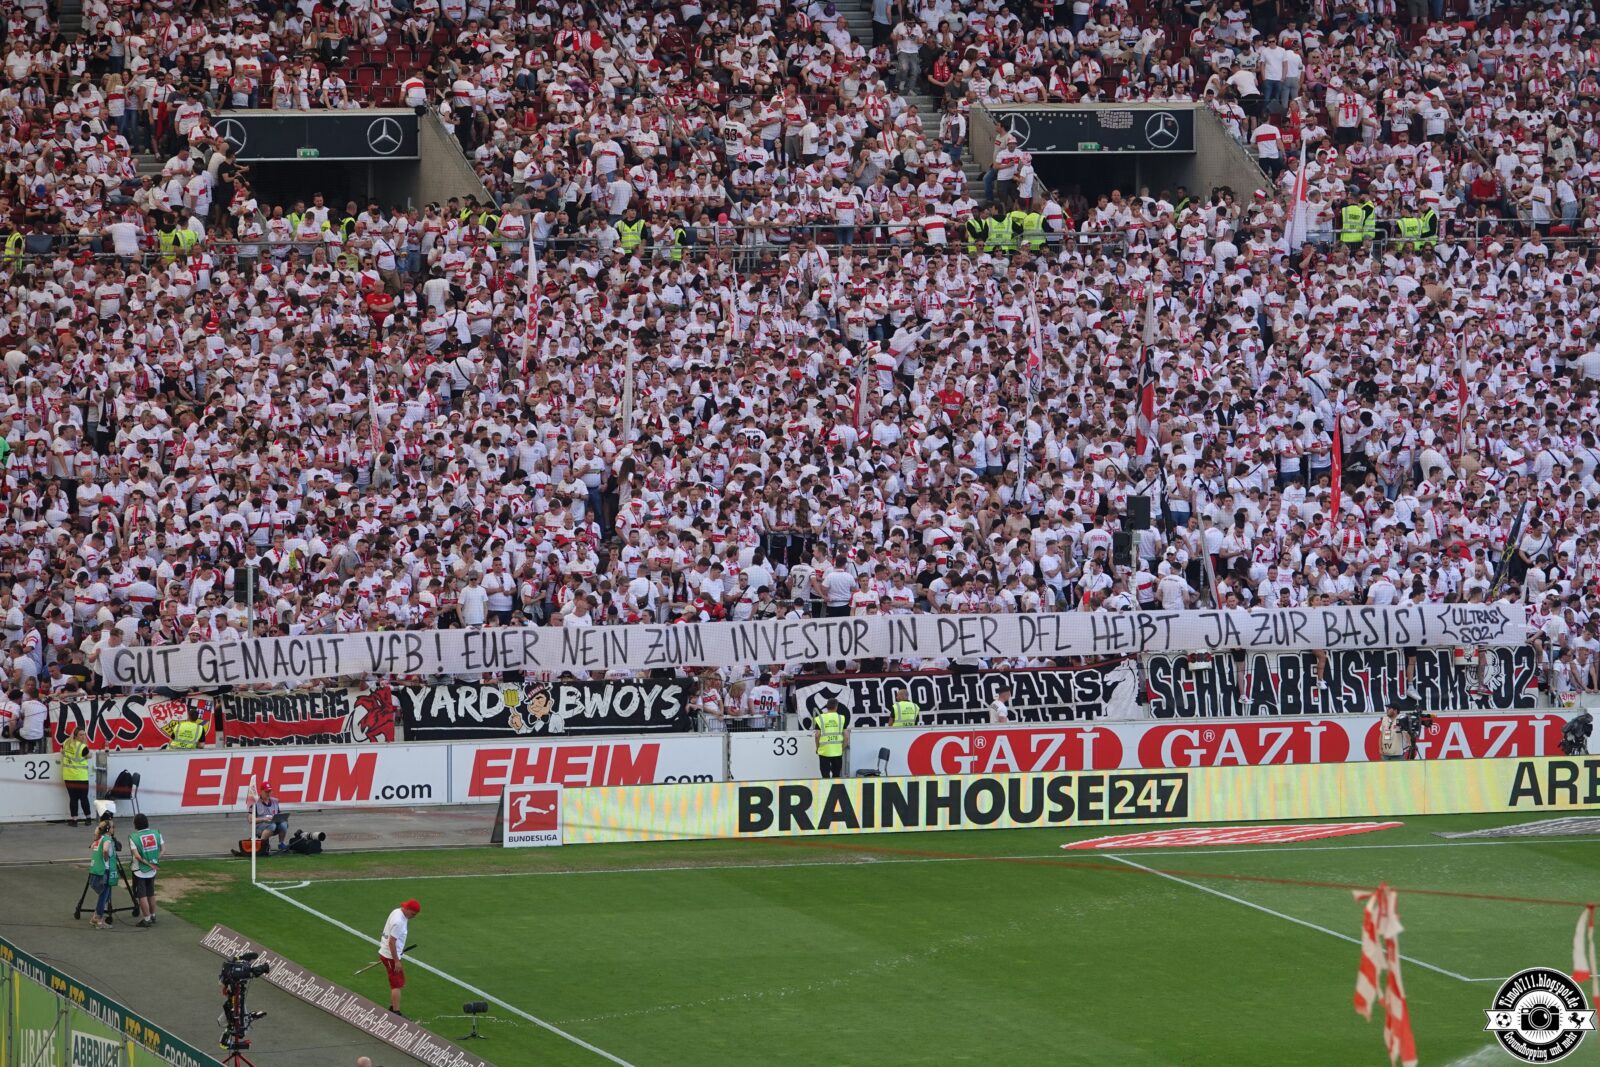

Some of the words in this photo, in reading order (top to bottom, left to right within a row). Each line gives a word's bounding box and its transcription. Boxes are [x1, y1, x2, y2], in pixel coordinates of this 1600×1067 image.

[1452, 607, 1500, 626] ULTRAS
[114, 648, 180, 684] GUT
[197, 638, 344, 683] GEMACHT
[461, 630, 540, 670] EUER
[561, 627, 628, 668] NEIN
[644, 624, 705, 665] ZUM
[731, 619, 870, 661] INVESTOR
[889, 616, 918, 654] IN
[937, 616, 1002, 655] DER
[1019, 614, 1072, 654] DFL
[1199, 612, 1240, 648] JA
[1250, 611, 1311, 647] ZUR
[222, 688, 349, 722] SUPPORTERS
[406, 684, 506, 723] YARD
[560, 684, 682, 721] BWOYS
[760, 695, 773, 711] 93
[848, 669, 1102, 714] HOOLIGANS
[773, 737, 798, 756] 33
[24, 761, 51, 780] 32
[508, 834, 557, 843] BUNDESLIGA
[17, 957, 47, 986] ITALIEN
[270, 958, 325, 1003] Mercedes-Benz
[316, 986, 348, 1013] Bank
[340, 995, 398, 1039] Mercedes-Benz
[388, 1022, 420, 1052] Bank
